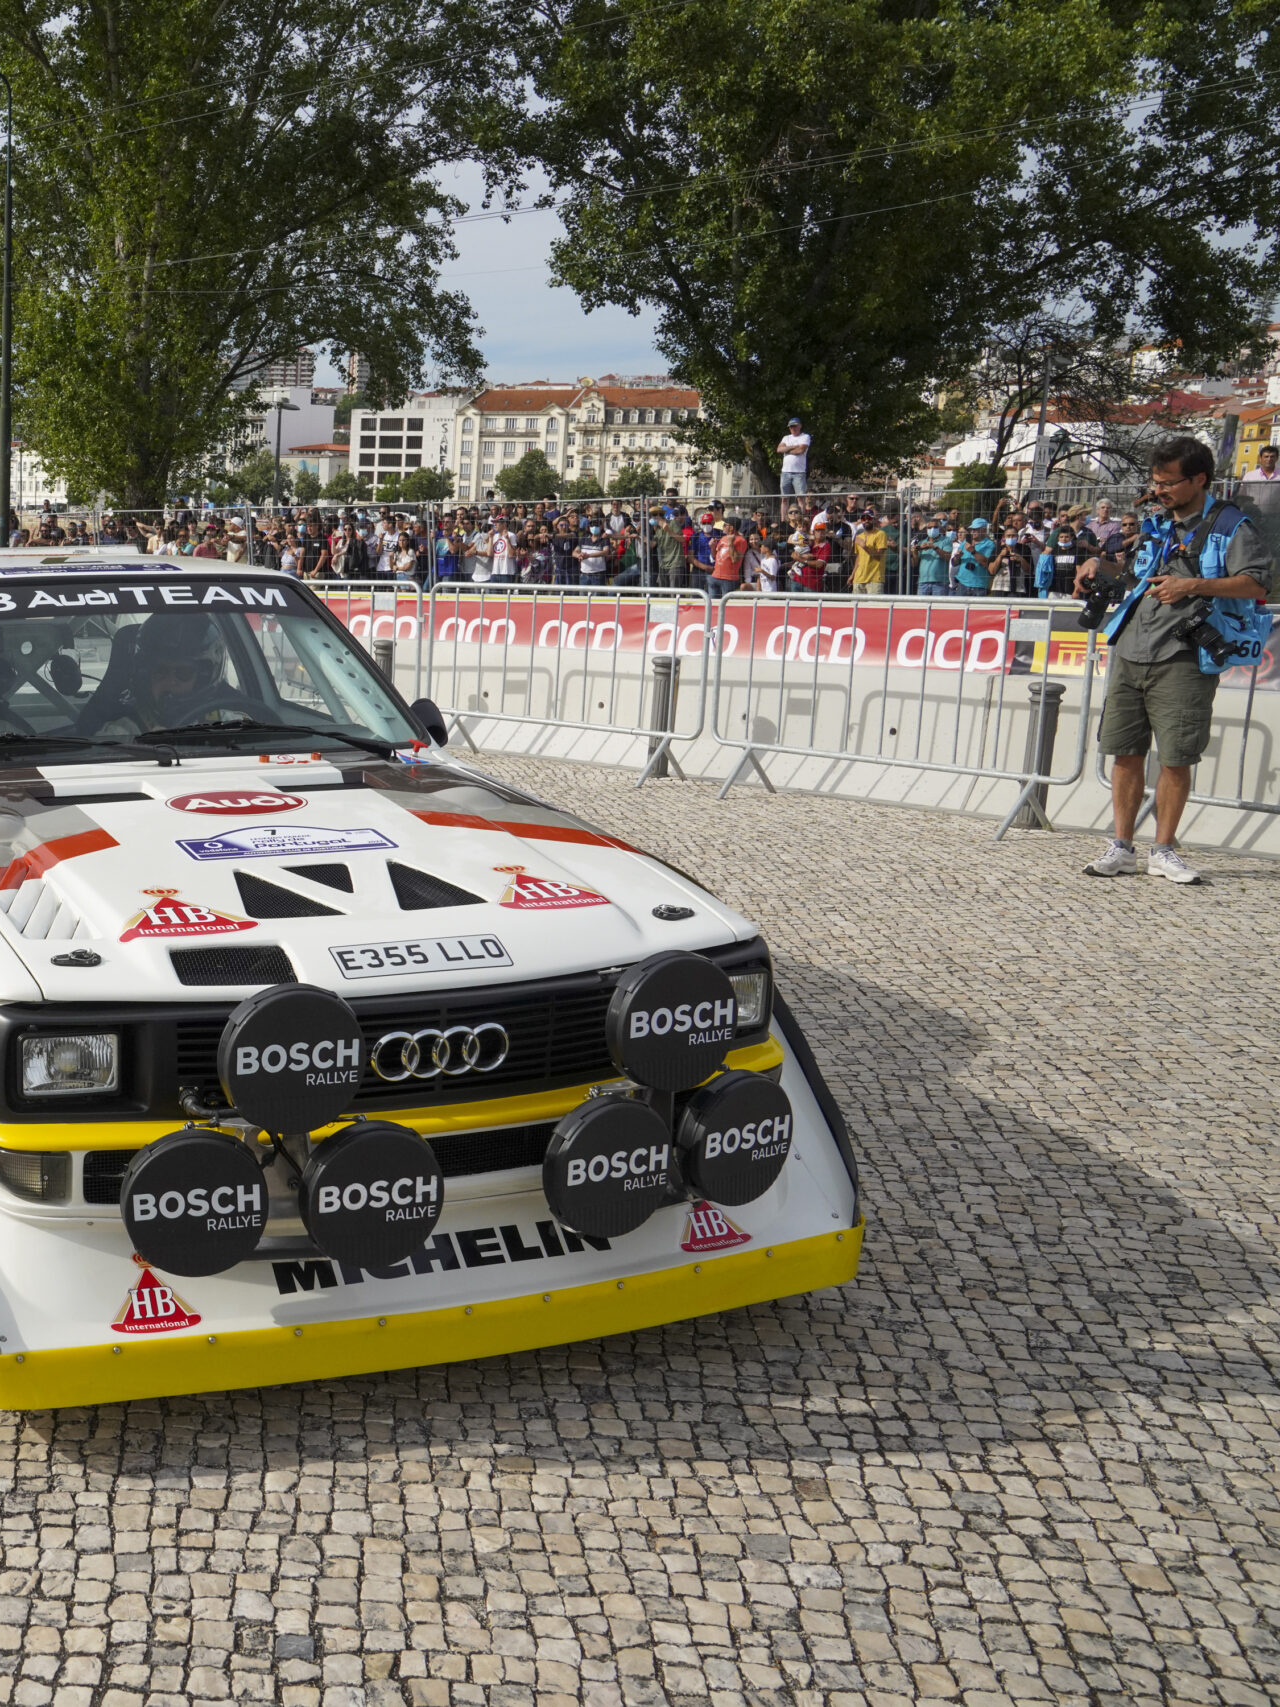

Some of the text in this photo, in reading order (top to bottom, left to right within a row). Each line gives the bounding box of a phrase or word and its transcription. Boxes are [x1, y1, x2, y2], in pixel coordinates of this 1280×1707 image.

[27, 589, 118, 610] Audi
[118, 585, 289, 608] TEAM
[765, 624, 866, 665] acp
[896, 628, 1006, 673] acp
[184, 796, 298, 811] Audi
[507, 880, 582, 900] HB
[144, 905, 218, 926] HB
[336, 944, 429, 971] E355
[630, 998, 734, 1039] BOSCH
[688, 1028, 733, 1046] RALLYE
[236, 1038, 360, 1075] BOSCH
[305, 1070, 358, 1086] RALLYE
[704, 1114, 792, 1159] BOSCH
[567, 1143, 669, 1187] BOSCH
[751, 1142, 788, 1161] RALLYE
[318, 1174, 438, 1214] BOSCH
[623, 1172, 667, 1192] RALLYE
[132, 1183, 261, 1222] BOSCH
[385, 1205, 436, 1222] RALLYE
[207, 1214, 262, 1231] RALLYE
[688, 1208, 729, 1240] HB
[271, 1220, 612, 1295] MIHELIN
[128, 1285, 177, 1320] HB
